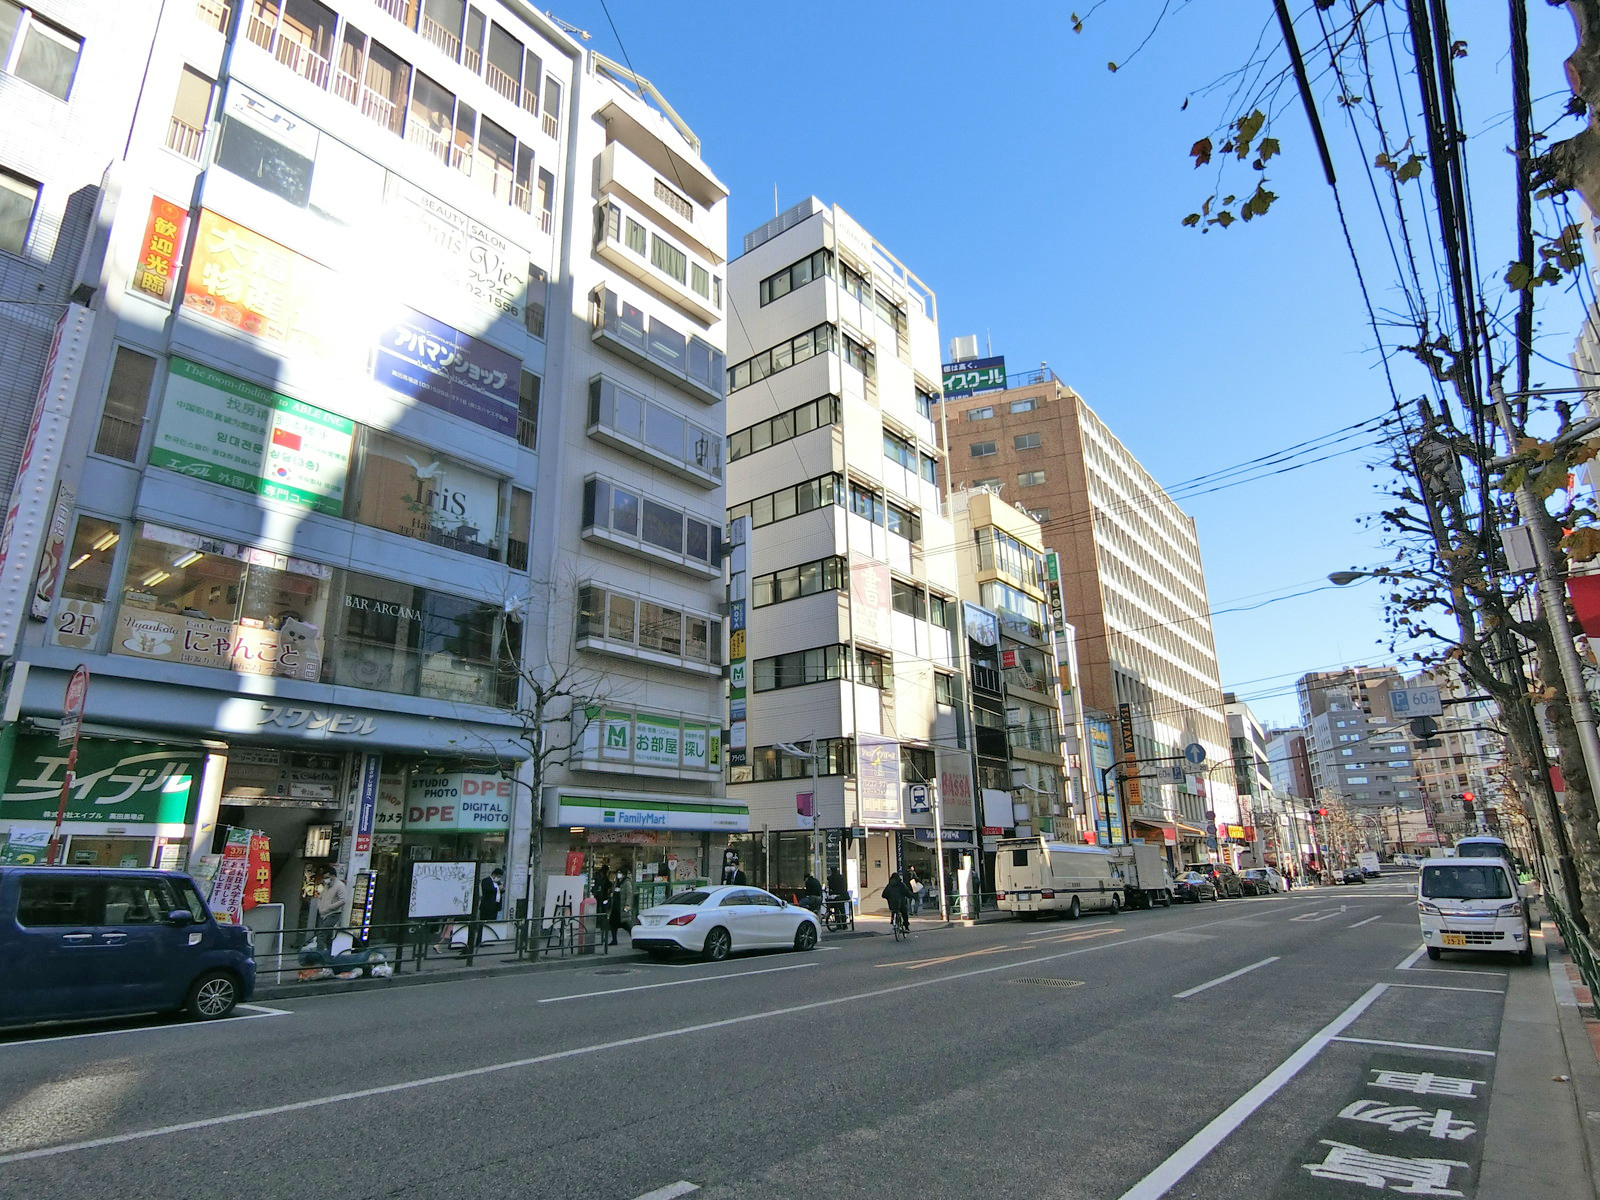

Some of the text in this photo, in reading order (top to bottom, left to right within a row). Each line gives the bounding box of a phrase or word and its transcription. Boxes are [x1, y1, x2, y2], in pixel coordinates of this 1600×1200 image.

[421, 196, 466, 227] BEAUTY
[471, 225, 507, 251] SALON
[141, 216, 178, 296] 歓迎光臨
[394, 326, 509, 390] アパマンショップ
[184, 363, 206, 378] The
[278, 398, 289, 408] to
[292, 401, 323, 419] ABLE
[323, 411, 346, 429] INC.
[165, 457, 214, 478] エイブル
[344, 595, 422, 622] BAR ARCANA
[733, 603, 741, 629] NOVA
[58, 612, 96, 636] 2F
[186, 619, 234, 634] Cat Cafe
[183, 629, 301, 668] にゃんこと
[1395, 692, 1436, 706] P 60分
[257, 704, 378, 735] スワンビル
[1120, 706, 1133, 749] TSUTAYA
[8, 752, 196, 805] エイブル
[411, 778, 450, 789] STUDIO
[462, 779, 512, 798] DPE
[941, 771, 972, 798] BASSA
[424, 788, 458, 798] PHOTO
[42, 810, 103, 821] 株式社エイブル
[408, 805, 456, 824] DPE
[462, 802, 503, 813] DIGITAL
[473, 812, 509, 823] PHOTO
[618, 811, 666, 826] FamilyMart
